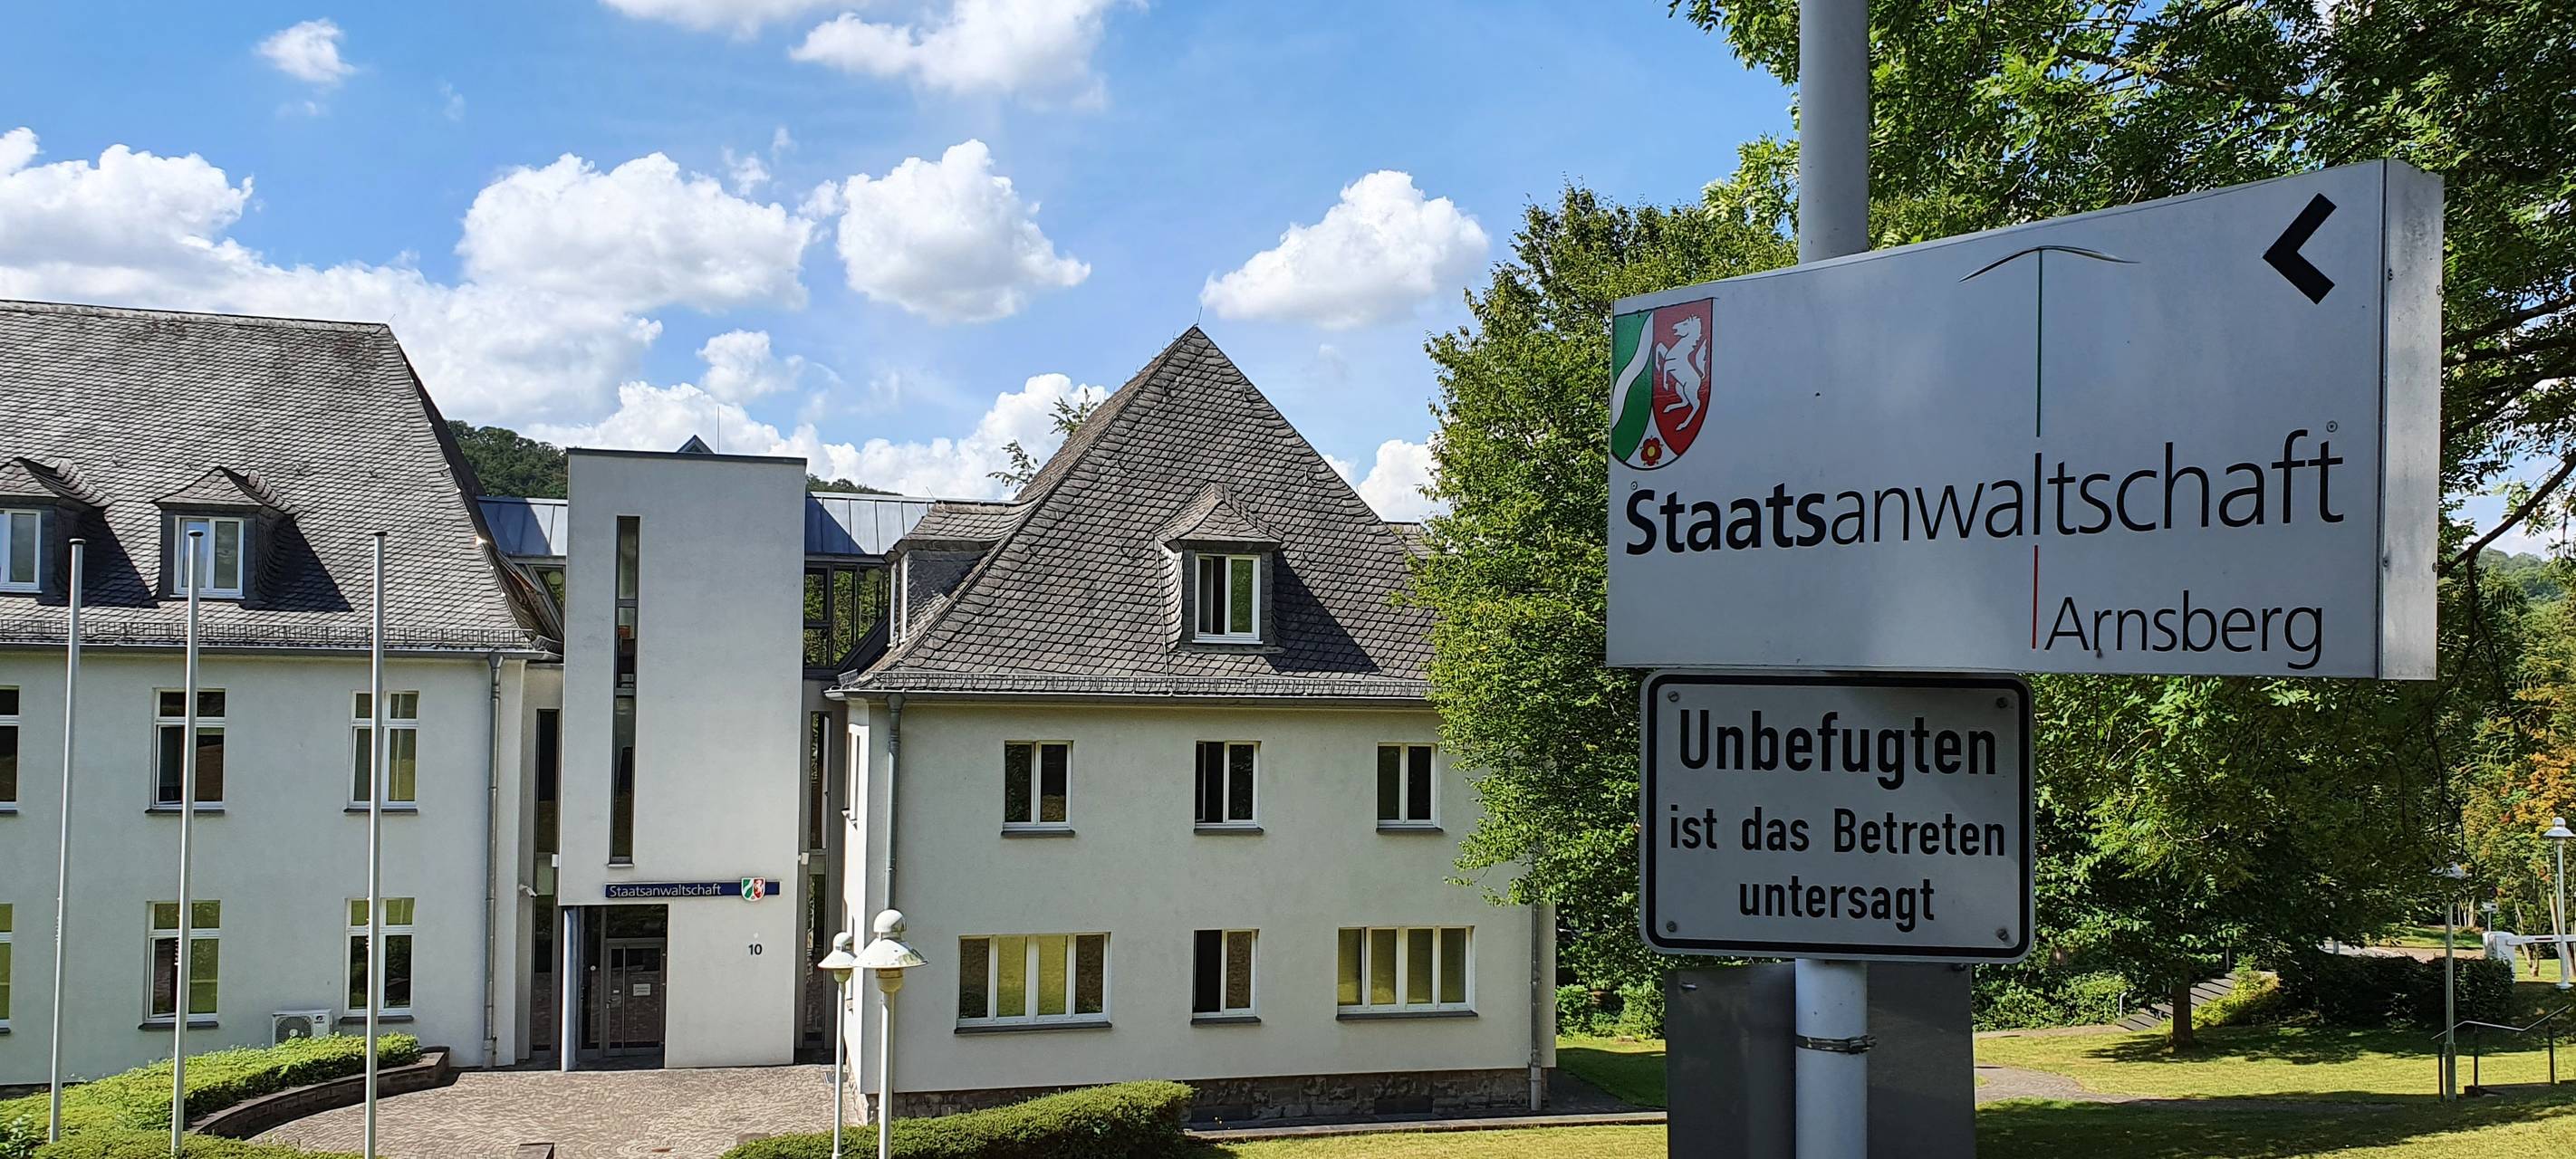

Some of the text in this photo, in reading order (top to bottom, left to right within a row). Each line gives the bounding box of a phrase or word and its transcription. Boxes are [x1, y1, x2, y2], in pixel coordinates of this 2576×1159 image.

[1626, 429, 2344, 555] Staatsanwaltschaft
[2044, 589, 2323, 670] Arnsberg
[1679, 709, 1996, 790] Unbefugten
[1670, 804, 2005, 857] ist das Betreten
[610, 884, 722, 897] Staatsanwaltschaft
[1739, 875, 1935, 933] untersagt
[748, 943, 763, 955] 10
